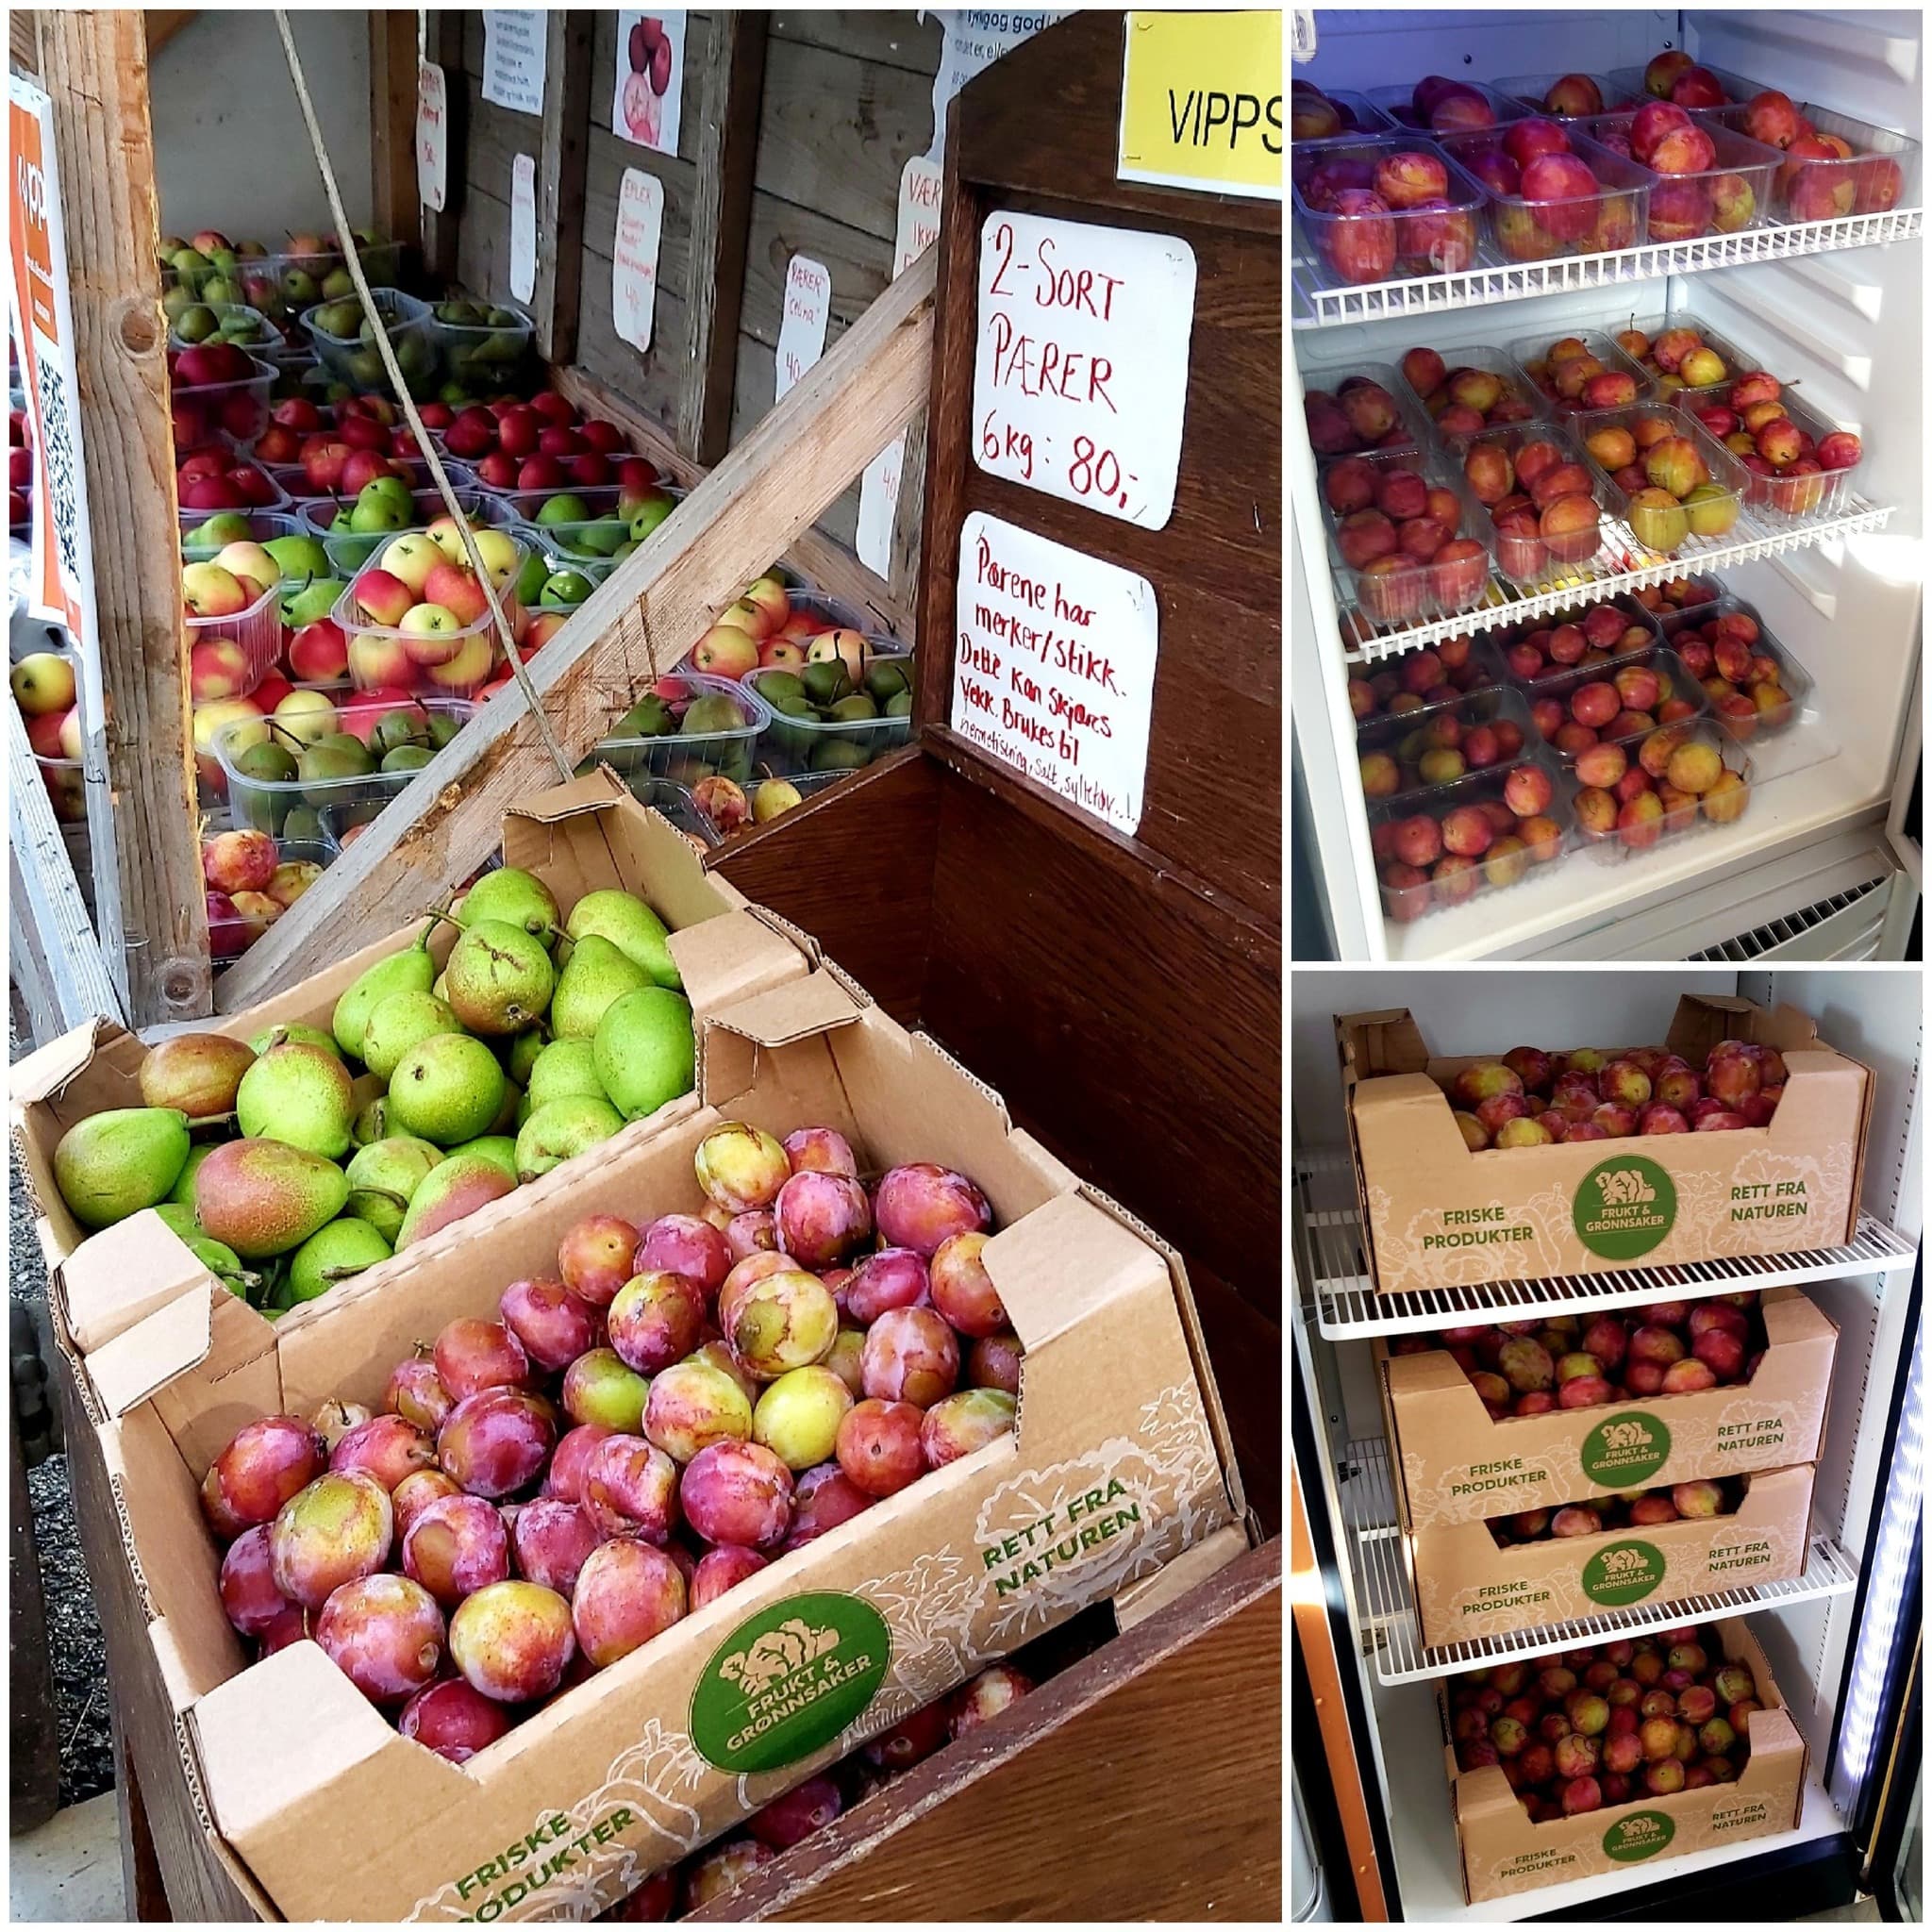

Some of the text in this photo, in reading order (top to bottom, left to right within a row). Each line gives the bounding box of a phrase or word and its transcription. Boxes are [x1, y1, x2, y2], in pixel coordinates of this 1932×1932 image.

[1168, 90, 1283, 154] VIPPS
[989, 312, 1117, 413] PÆRER
[1055, 583, 1096, 626] har
[960, 632, 1001, 680] Dette
[1011, 666, 1041, 706] kan
[1002, 698, 1056, 749] Brukes
[1730, 1180, 1807, 1201] RETT FRA
[1443, 1207, 1505, 1226] FRISKE
[1601, 1206, 1650, 1219] FRUKT &
[1729, 1201, 1807, 1222] NATUREN
[1423, 1226, 1533, 1250] PRODUKTER
[1717, 1418, 1783, 1438] RETT FRA
[1606, 1447, 1638, 1459] FRUKT
[1717, 1433, 1785, 1453] NATUREN
[1469, 1457, 1524, 1477] FRISKE
[1452, 1470, 1547, 1496] PRODUKTER
[981, 1476, 1127, 1571] RETT FRA
[994, 1502, 1141, 1598] NATUREN
[1708, 1541, 1770, 1559] RETT FRA
[1708, 1554, 1771, 1572] NATUREN
[1605, 1570, 1636, 1582] FRUKT
[1479, 1581, 1528, 1597] FRISKE
[1461, 1591, 1550, 1615] PRODUKTER
[747, 1655, 841, 1719] FRUKT &
[726, 1654, 872, 1751] GRØNNSAKER
[1712, 1803, 1766, 1821] RETT FRA
[1712, 1812, 1767, 1831] NATUREN
[456, 1811, 571, 1901] FRISKE
[458, 1807, 636, 1923] ODUKTER
[1501, 1855, 1576, 1878] PRODUKTER
[1515, 1848, 1557, 1865] FRISKE
